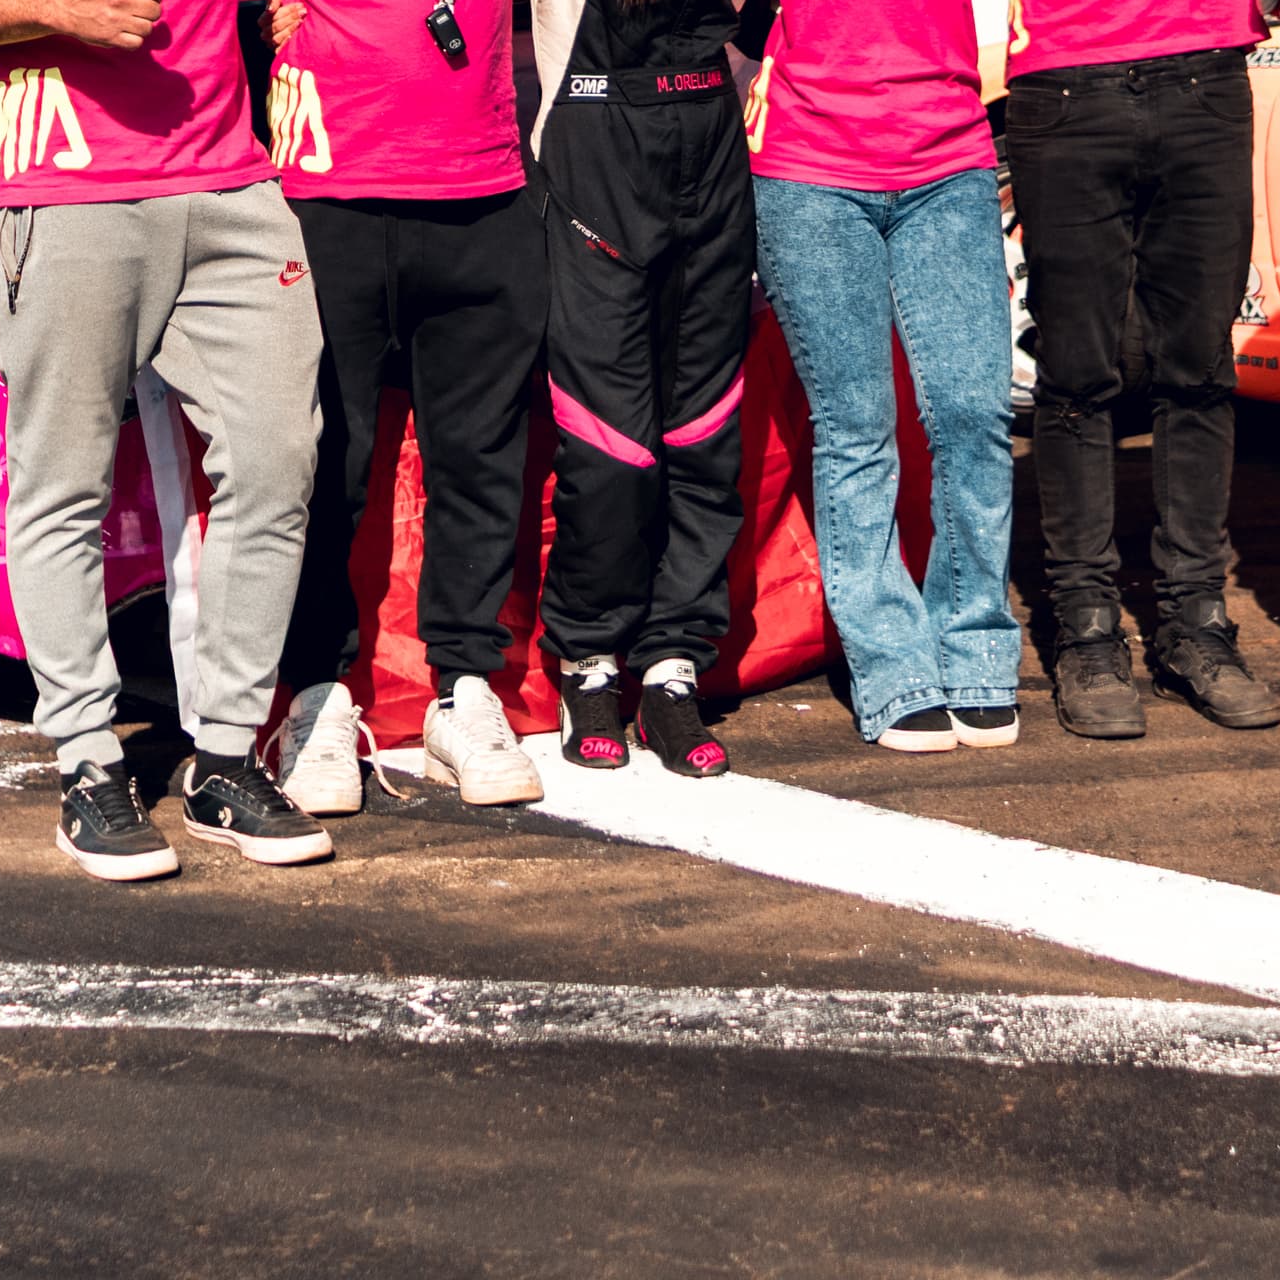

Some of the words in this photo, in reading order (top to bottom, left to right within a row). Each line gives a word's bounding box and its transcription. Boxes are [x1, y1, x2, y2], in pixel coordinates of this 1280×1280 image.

[570, 78, 608, 94] OMP
[657, 76, 675, 94] M.
[285, 260, 304, 273] NIKE
[577, 660, 599, 669] OMP
[580, 740, 624, 757] OMP
